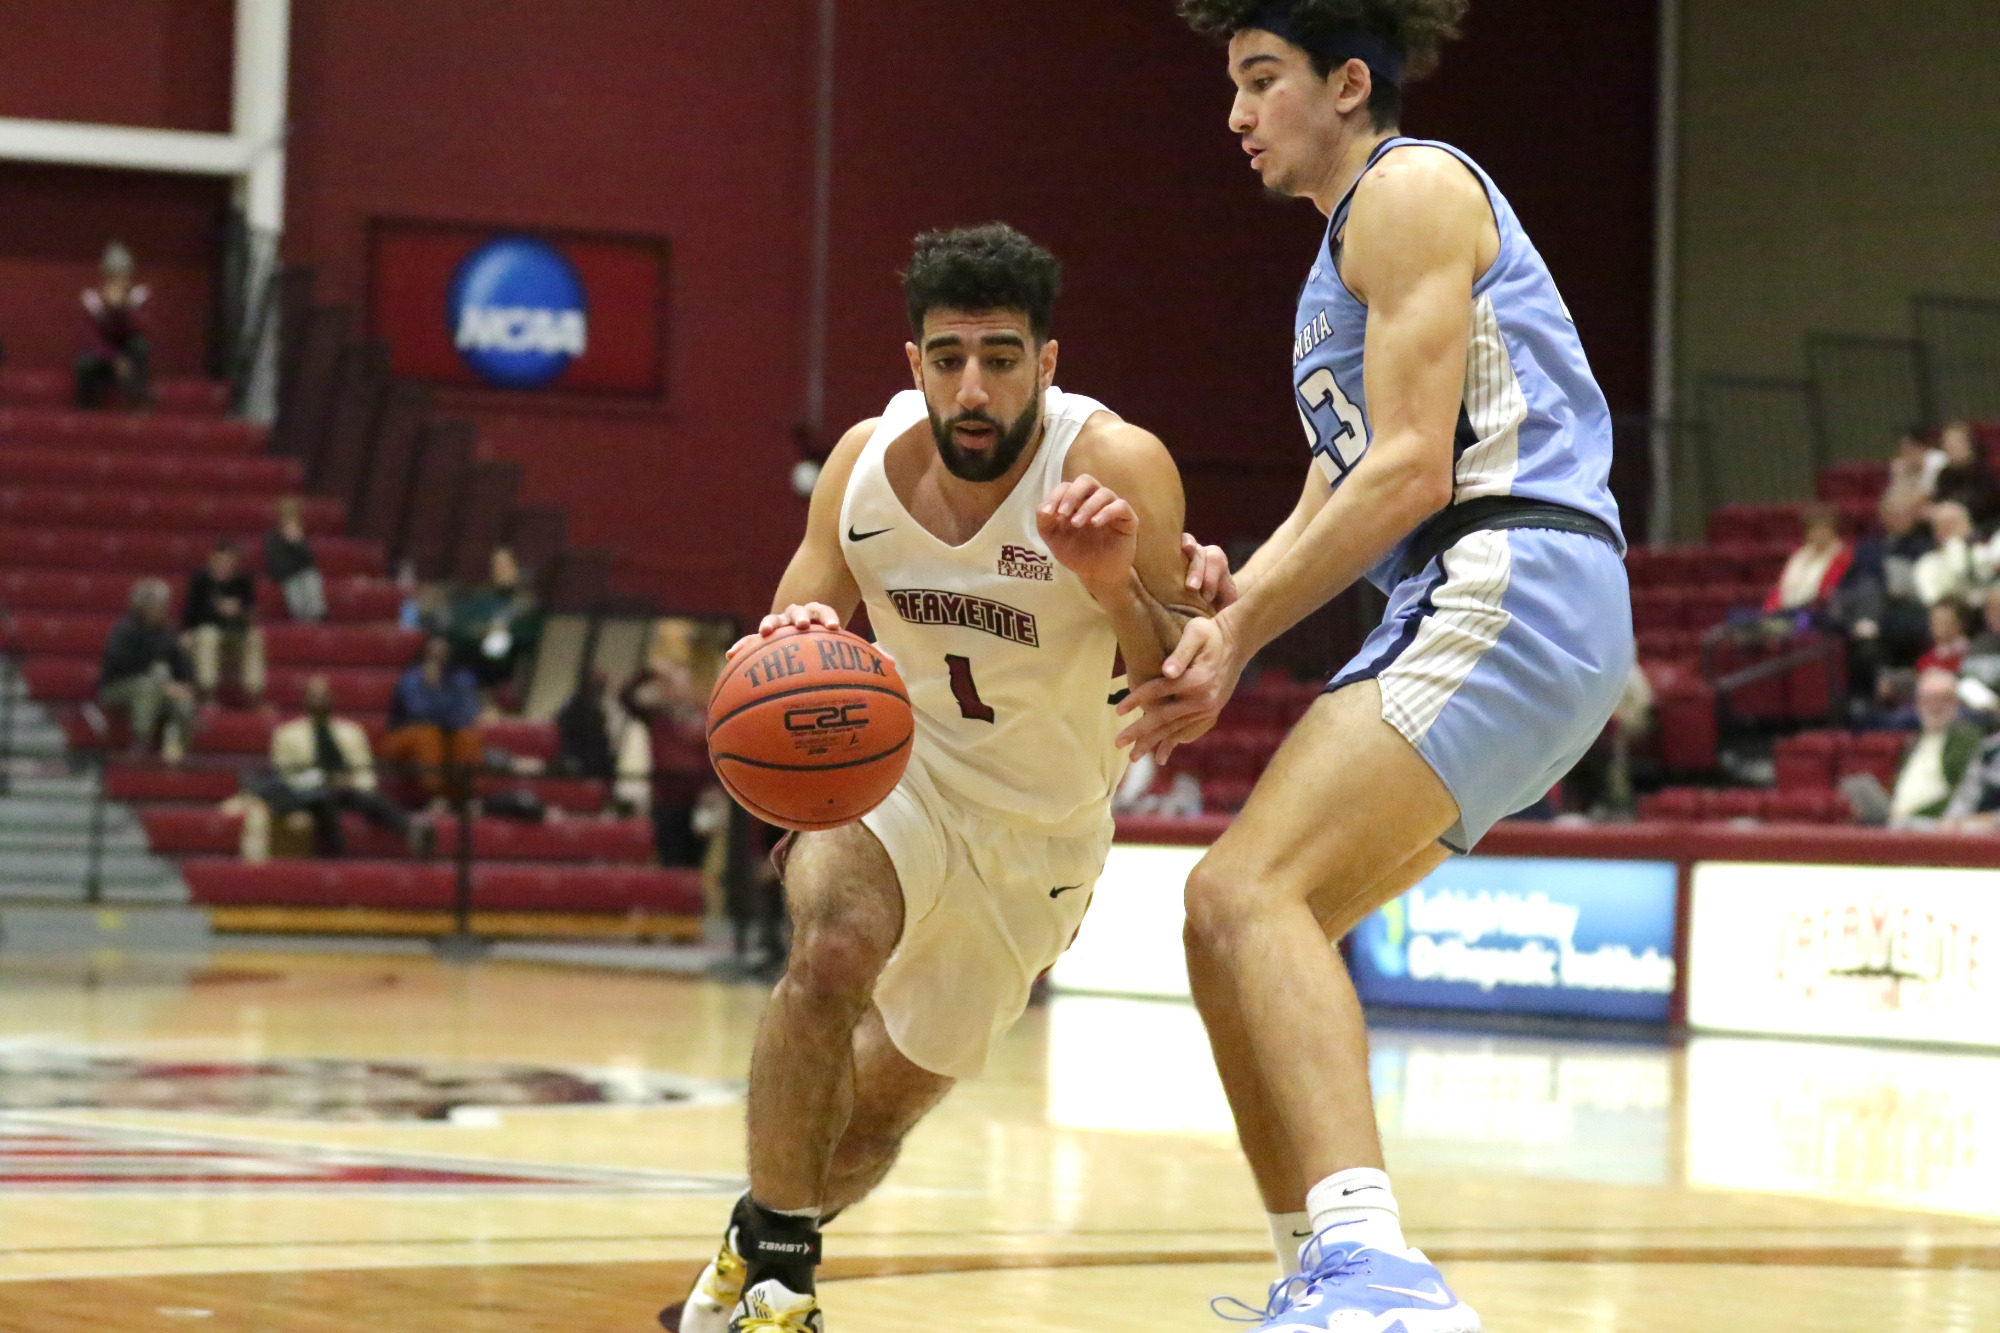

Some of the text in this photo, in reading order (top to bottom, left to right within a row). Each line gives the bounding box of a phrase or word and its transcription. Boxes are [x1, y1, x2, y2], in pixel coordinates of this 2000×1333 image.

[455, 306, 587, 357] NCAA
[997, 560, 1053, 573] PATRIOT
[998, 568, 1053, 581] LEAGUE
[887, 589, 1038, 647] AFAYETTE
[744, 639, 886, 688] THE ROCK
[944, 653, 995, 724] 1
[784, 703, 870, 731] C2C
